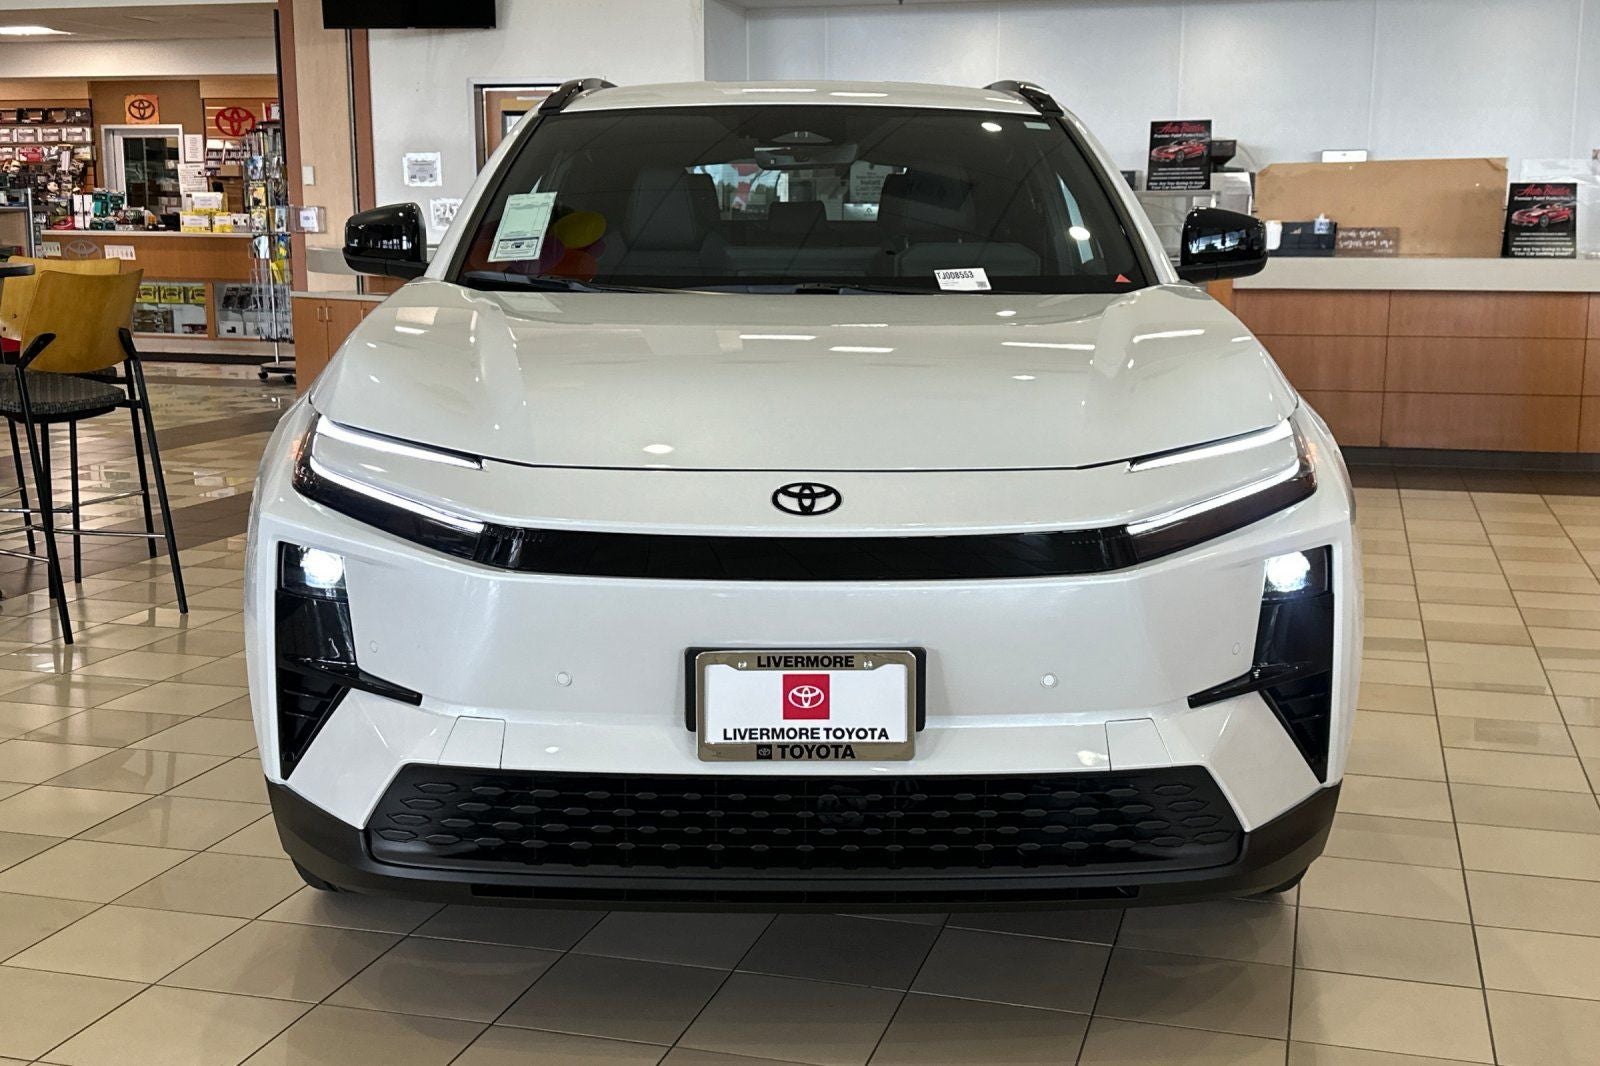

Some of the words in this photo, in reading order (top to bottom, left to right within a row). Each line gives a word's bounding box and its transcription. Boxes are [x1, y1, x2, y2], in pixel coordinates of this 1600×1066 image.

[757, 655, 854, 668] LIVERMORE
[723, 727, 820, 740] LIVERMORE
[824, 727, 890, 740] TOYOTA
[777, 744, 856, 759] TOYOTA
